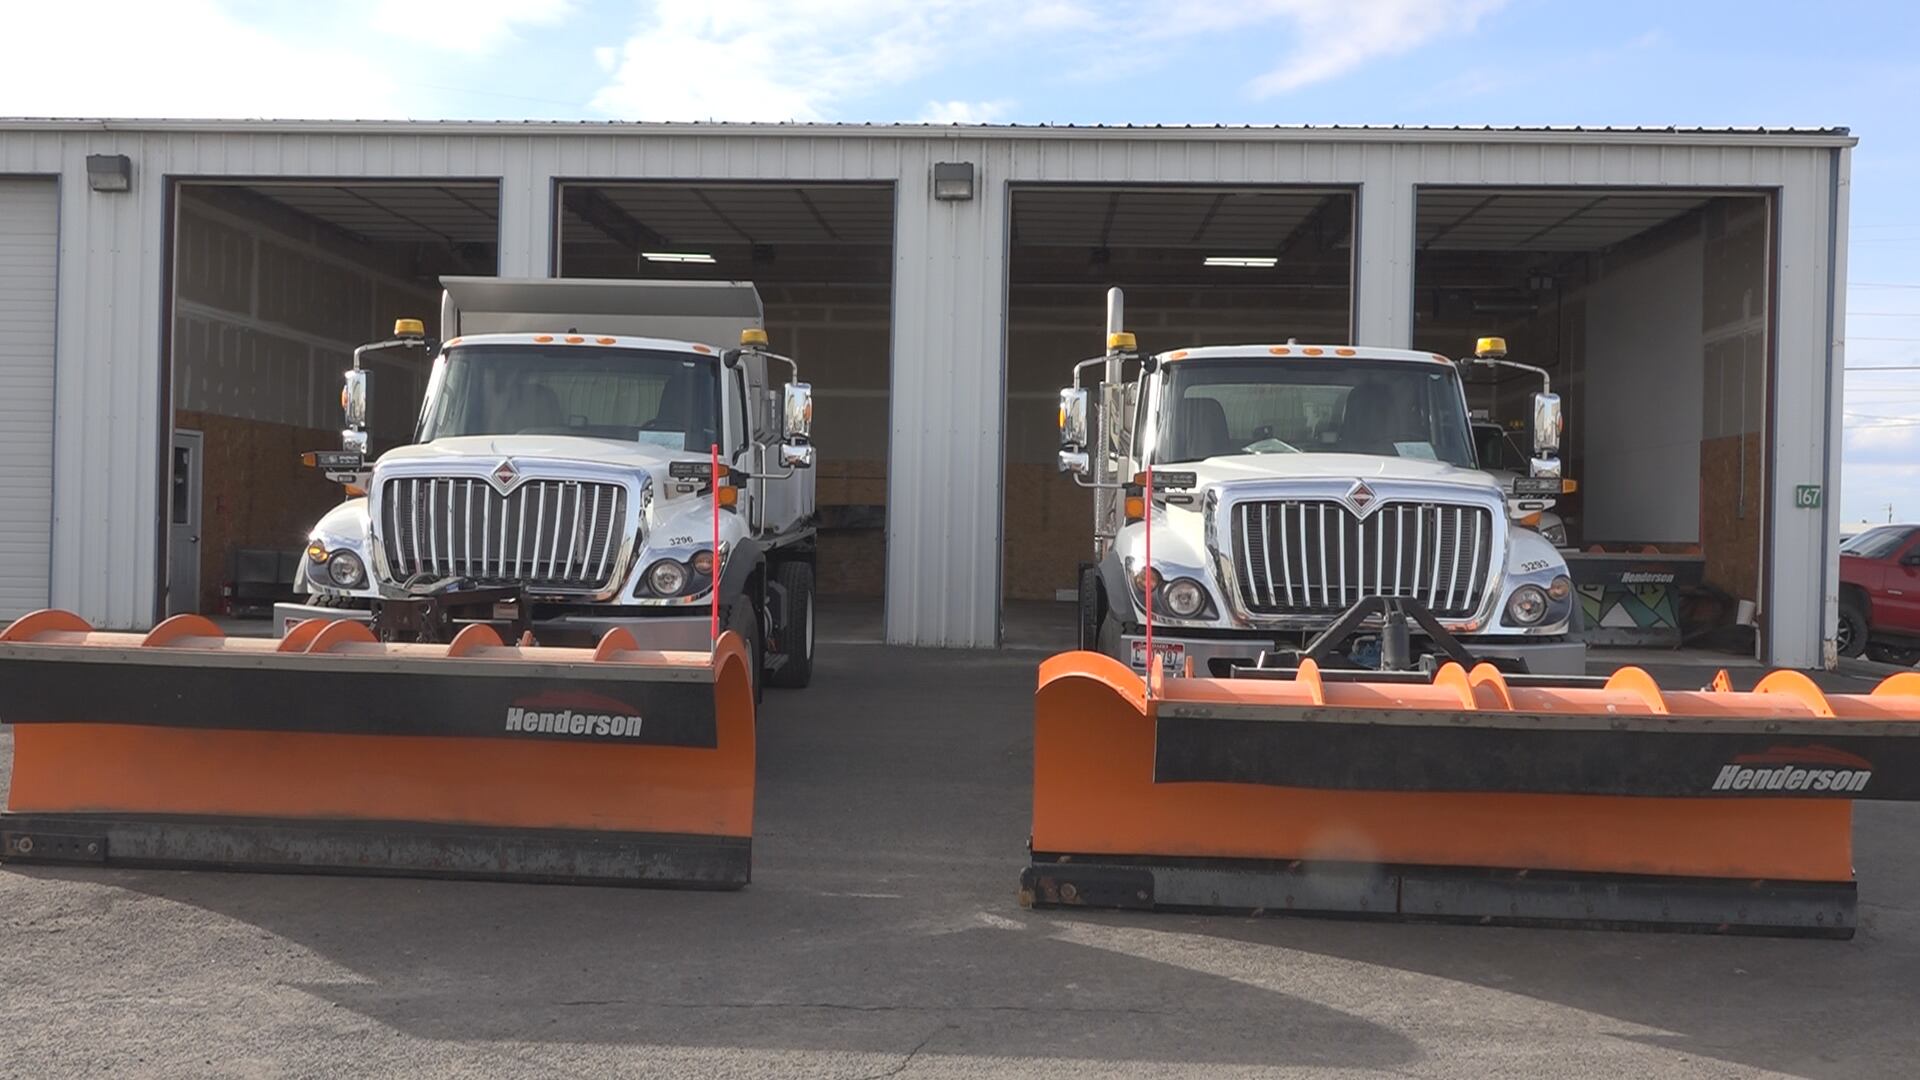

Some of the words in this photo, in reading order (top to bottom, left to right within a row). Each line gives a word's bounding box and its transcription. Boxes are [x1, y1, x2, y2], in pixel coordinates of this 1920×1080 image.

[1798, 488, 1820, 505] 167
[1621, 572, 1674, 583] Henderson
[505, 707, 643, 737] Henderson
[1711, 764, 1872, 792] Henderson
